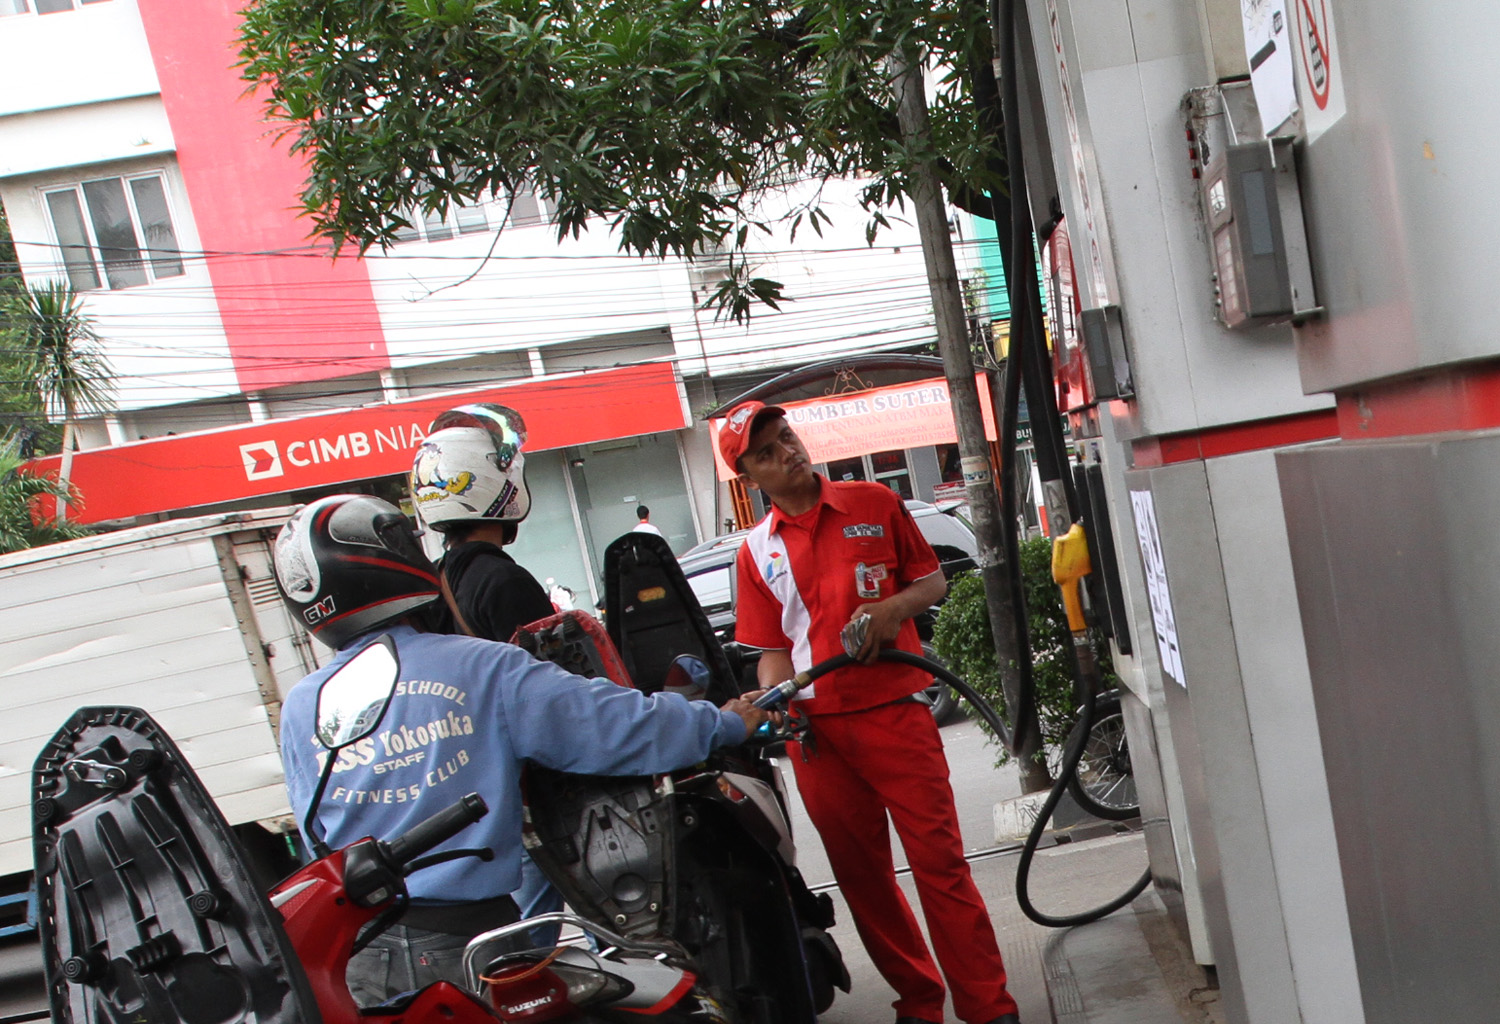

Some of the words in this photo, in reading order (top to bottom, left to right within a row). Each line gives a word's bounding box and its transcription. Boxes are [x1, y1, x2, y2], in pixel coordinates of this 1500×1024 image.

[785, 399, 869, 423] UMBER
[873, 387, 949, 411] SUTER
[286, 431, 371, 467] CIMB
[374, 420, 435, 453] NIA
[303, 595, 336, 625] GM
[396, 680, 467, 706] SCHOOL
[379, 711, 474, 757] Yokosuka
[331, 784, 421, 805] FITNESS
[426, 749, 470, 788] CLUB
[373, 752, 426, 775] STAFF
[508, 996, 552, 1014] SUZUKI
